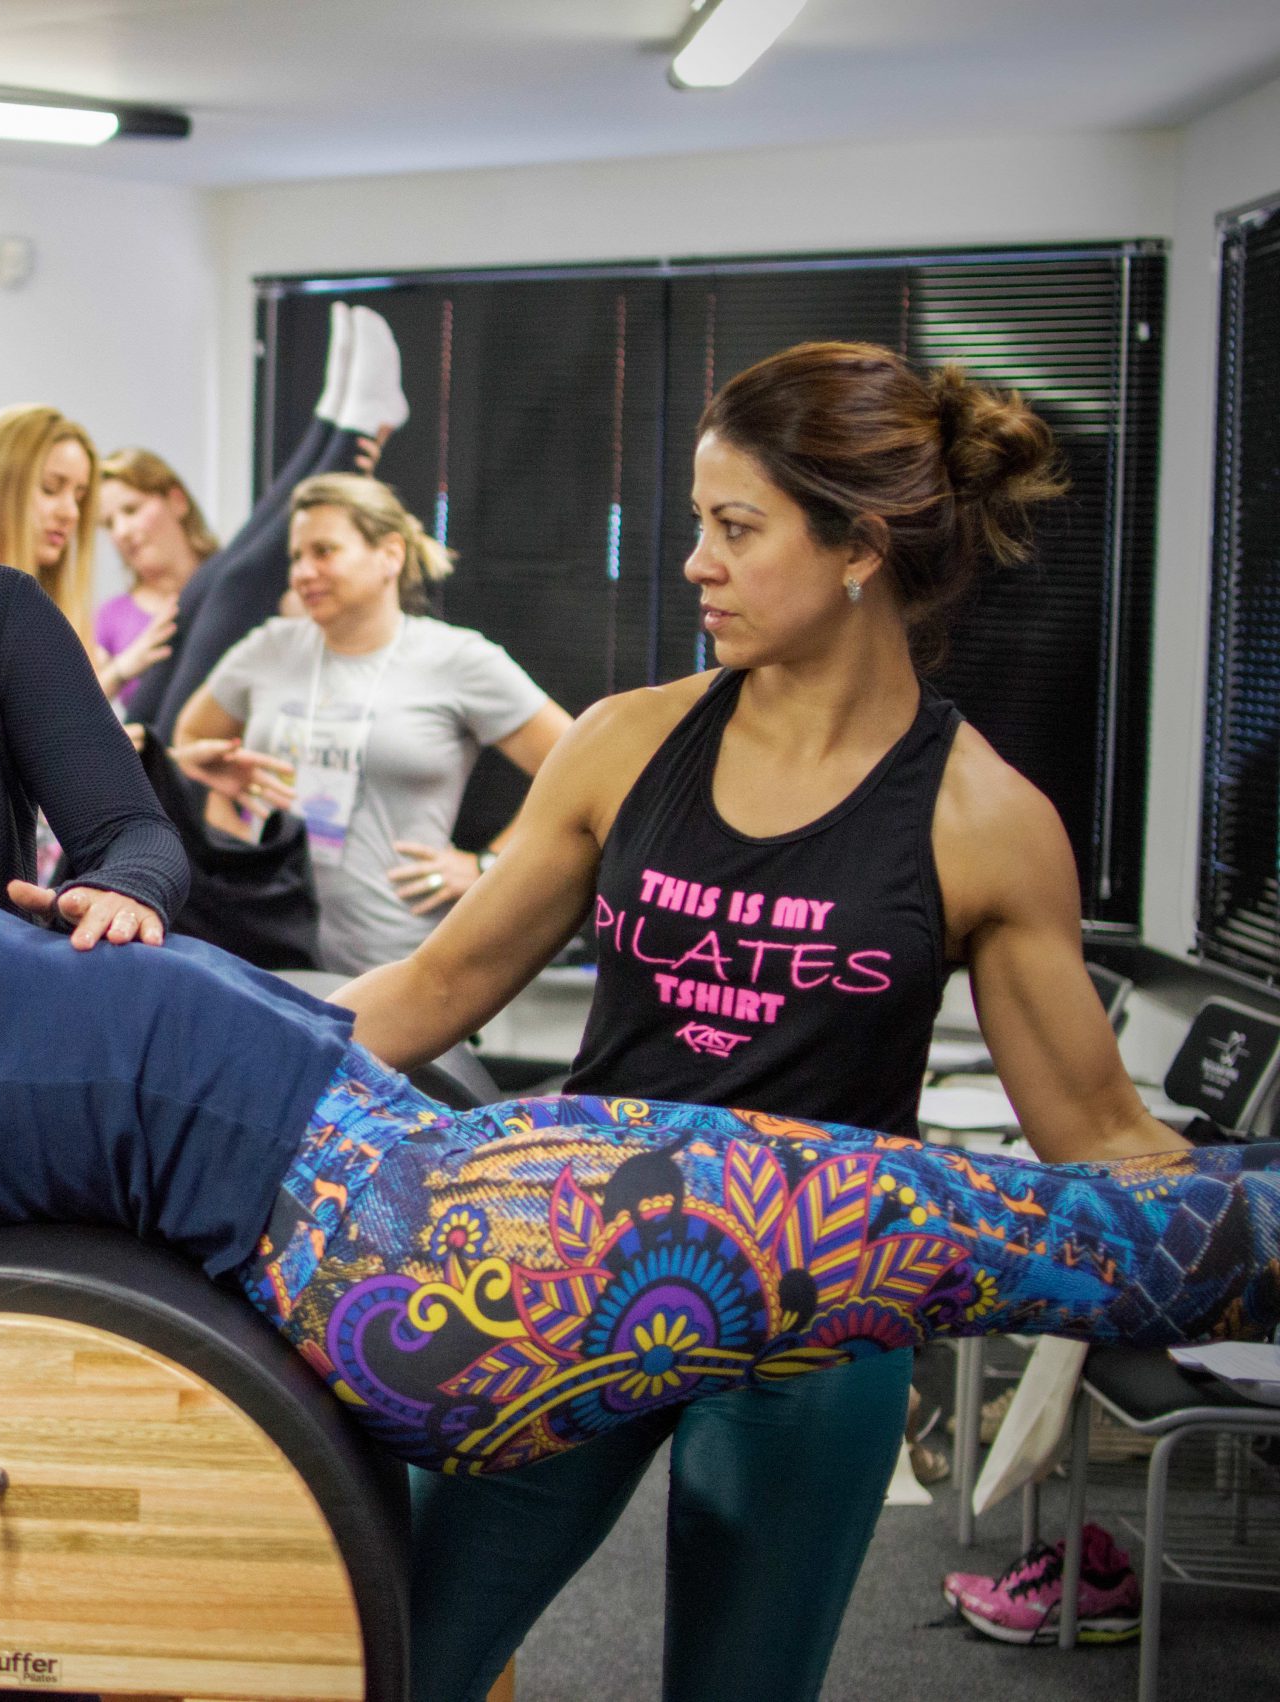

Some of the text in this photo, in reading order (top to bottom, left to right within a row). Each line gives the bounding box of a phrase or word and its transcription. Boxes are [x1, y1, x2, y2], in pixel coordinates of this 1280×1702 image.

[639, 868, 837, 932] THIS IS MY
[595, 894, 893, 994] PILATES
[654, 972, 787, 1025] TSHIRT
